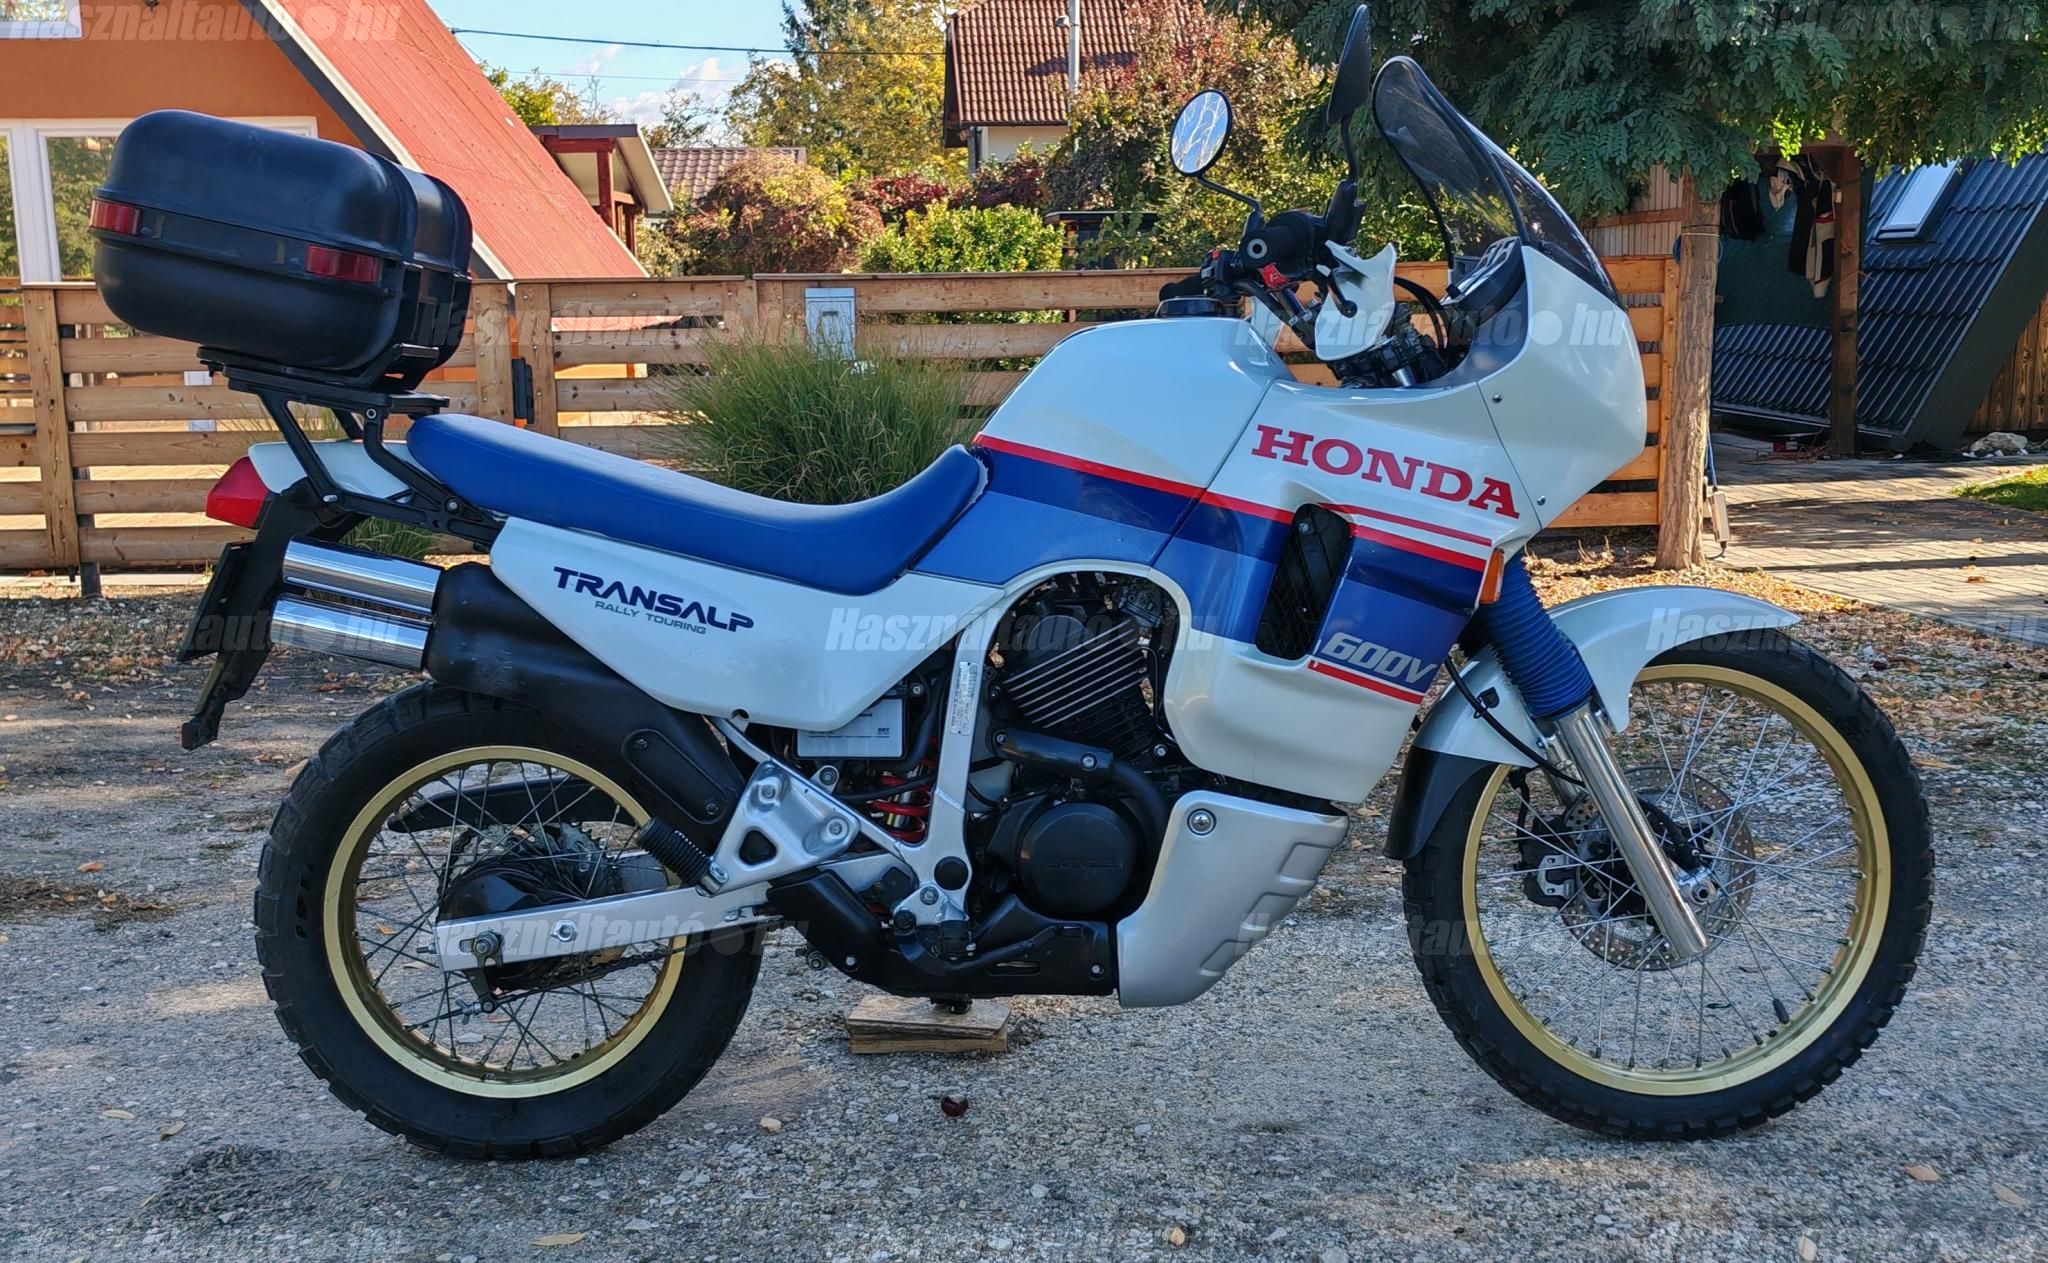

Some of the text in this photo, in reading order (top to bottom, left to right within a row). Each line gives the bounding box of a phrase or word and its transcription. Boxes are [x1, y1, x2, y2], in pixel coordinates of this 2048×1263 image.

[1251, 424, 1520, 519] HONDA
[553, 566, 754, 633] TRANSALP
[594, 600, 707, 635] RALLY TOURING
[1319, 632, 1438, 684] 600V
